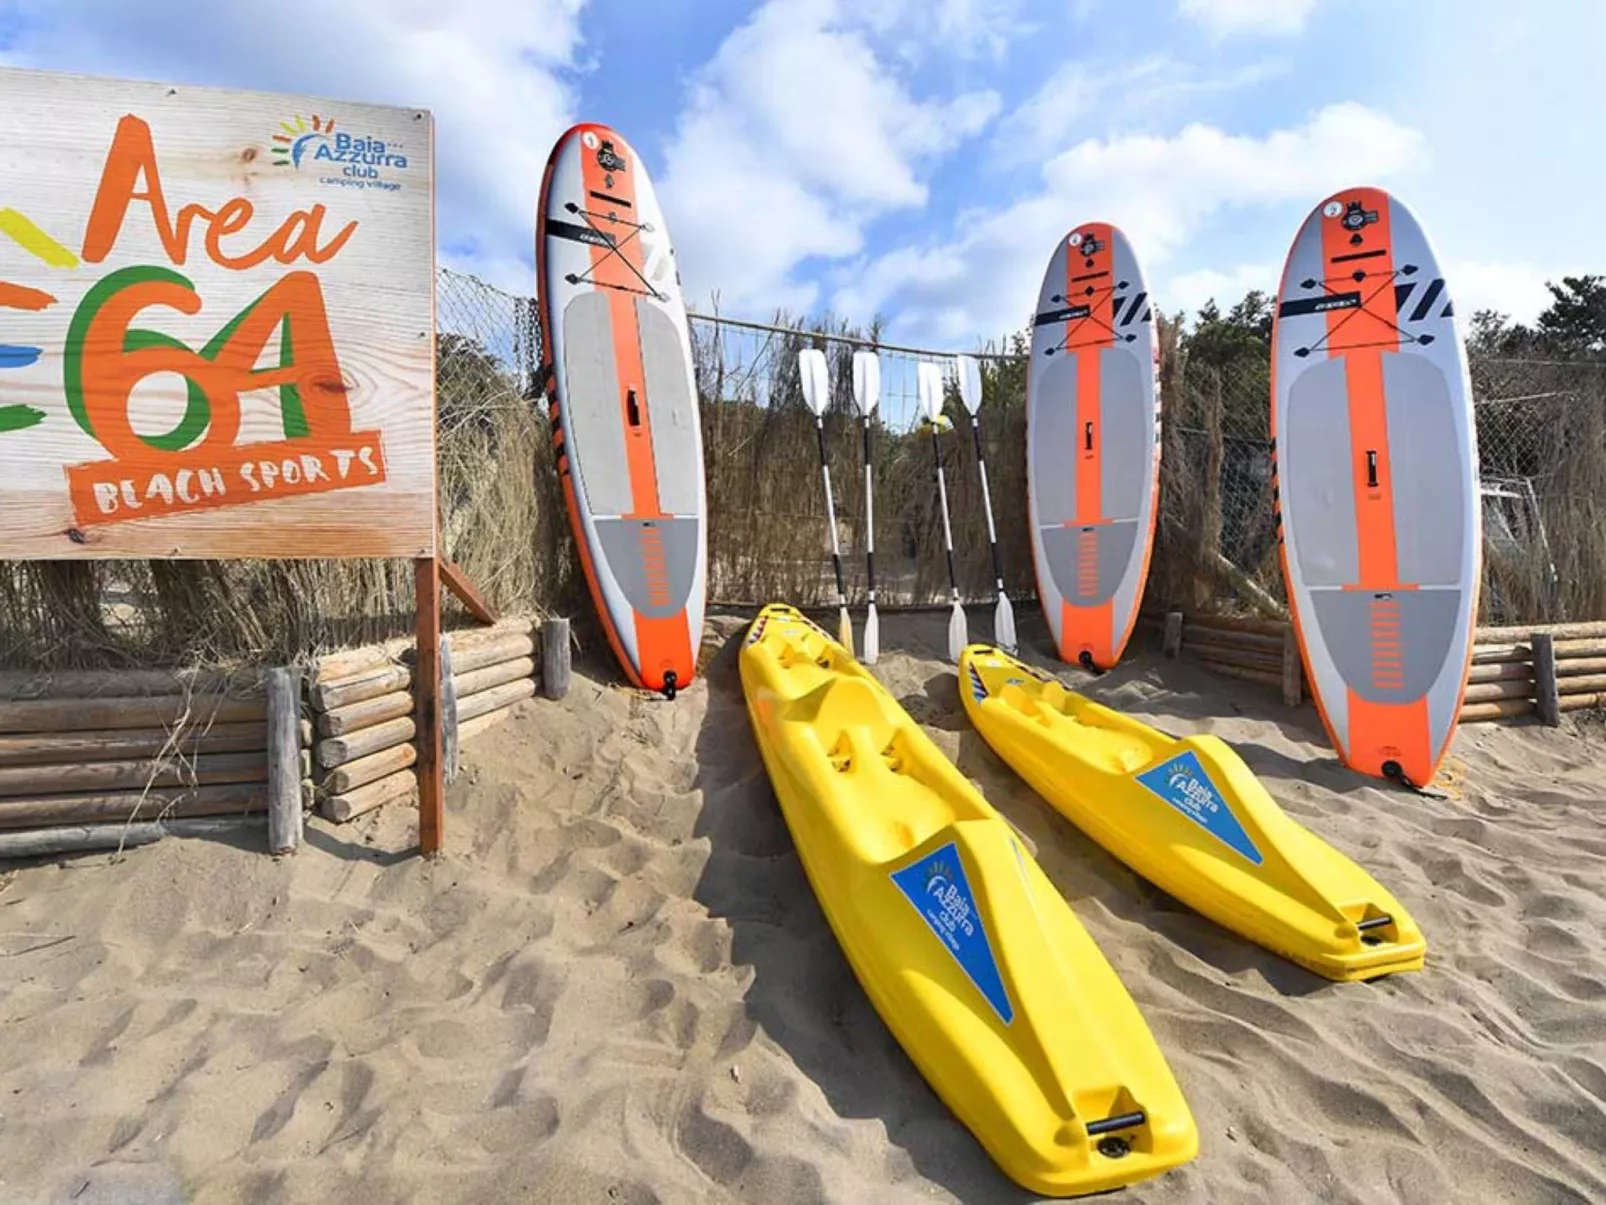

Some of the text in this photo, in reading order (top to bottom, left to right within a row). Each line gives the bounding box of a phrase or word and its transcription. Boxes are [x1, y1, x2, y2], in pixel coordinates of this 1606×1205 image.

[314, 144, 407, 168] Azzurra
[342, 163, 379, 179] club
[81, 113, 358, 270] Area
[64, 265, 352, 460] 64
[93, 446, 380, 514] BEACH SPORTS
